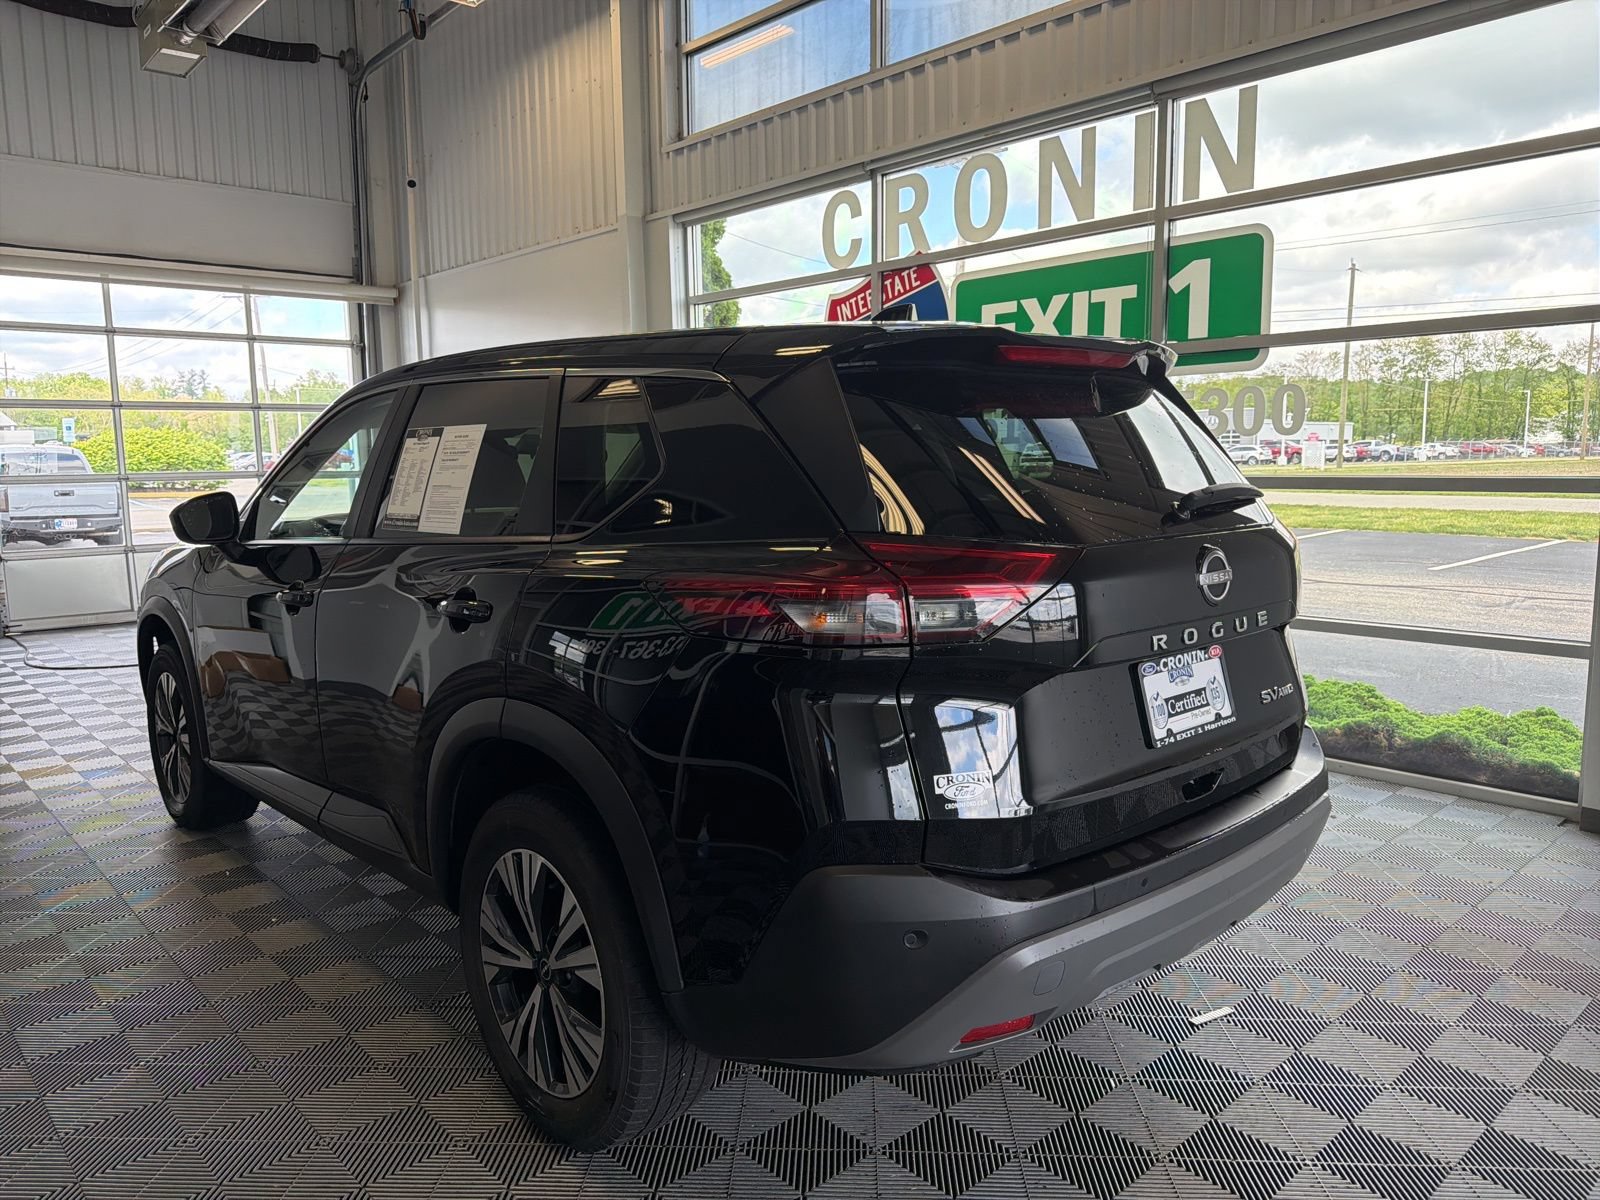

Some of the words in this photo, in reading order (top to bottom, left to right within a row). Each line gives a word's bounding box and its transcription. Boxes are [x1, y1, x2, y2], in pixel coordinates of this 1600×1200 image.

[821, 84, 1259, 270] CRONIN
[837, 267, 920, 321] INTETATE
[981, 284, 1138, 338] EXIT
[1168, 258, 1212, 339] 1
[1183, 384, 1306, 437] 300
[1201, 571, 1232, 584] NISSAN
[1152, 611, 1268, 651] ROGUE
[1160, 650, 1205, 671] CRONIN
[1169, 667, 1193, 682] CRONIN
[1168, 691, 1207, 714] Certified
[1261, 686, 1278, 704] SV
[1156, 737, 1175, 748] I-74
[1176, 728, 1196, 741] EXIT
[1205, 716, 1237, 731] Harrison
[936, 772, 991, 789] CRONIN
[953, 785, 977, 797] Ford
